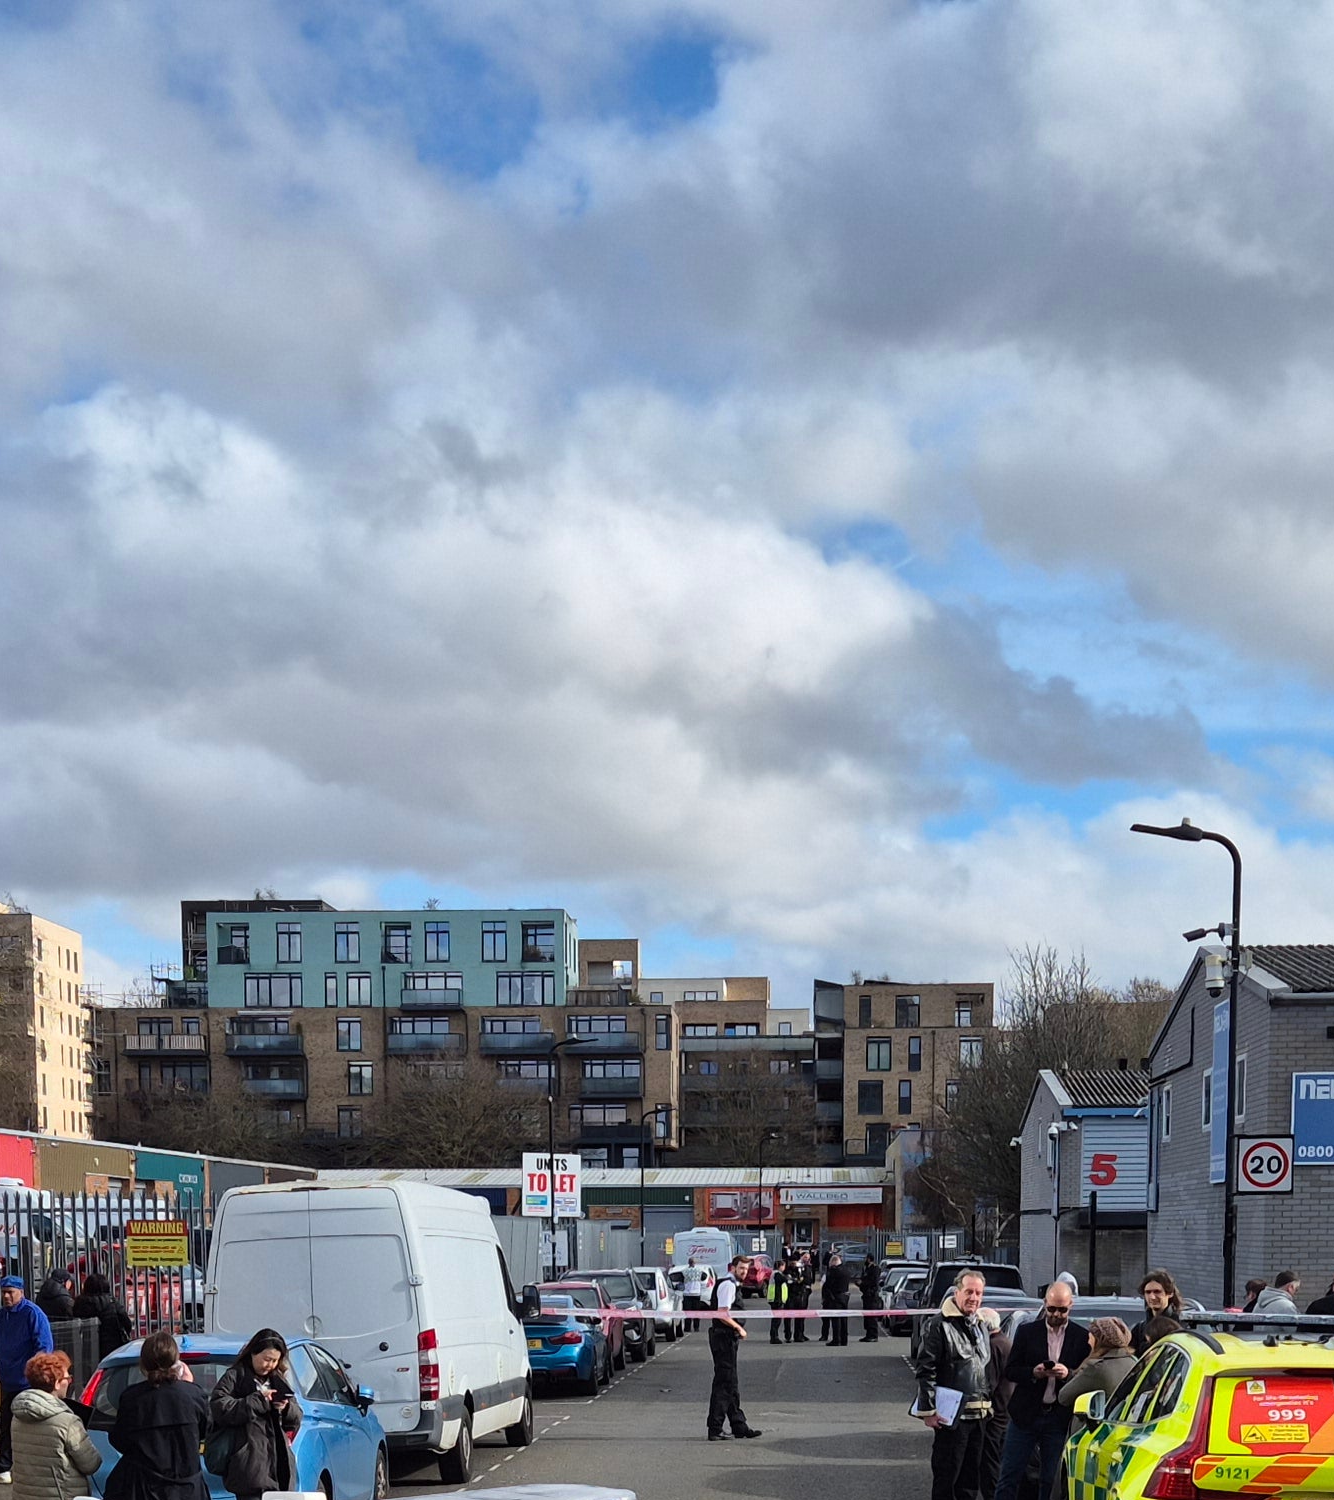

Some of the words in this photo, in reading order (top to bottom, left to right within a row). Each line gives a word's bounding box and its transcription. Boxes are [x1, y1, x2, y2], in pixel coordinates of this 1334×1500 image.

[1298, 1145, 1334, 1158] 0800
[536, 1157, 568, 1172] UNTS
[1089, 1153, 1118, 1186] 5
[1249, 1155, 1283, 1175] 20
[527, 1173, 547, 1192] TO
[553, 1174, 577, 1193] LET
[130, 1222, 184, 1234] WARNING
[1268, 1408, 1306, 1422] 999
[1215, 1467, 1250, 1480] 9121
